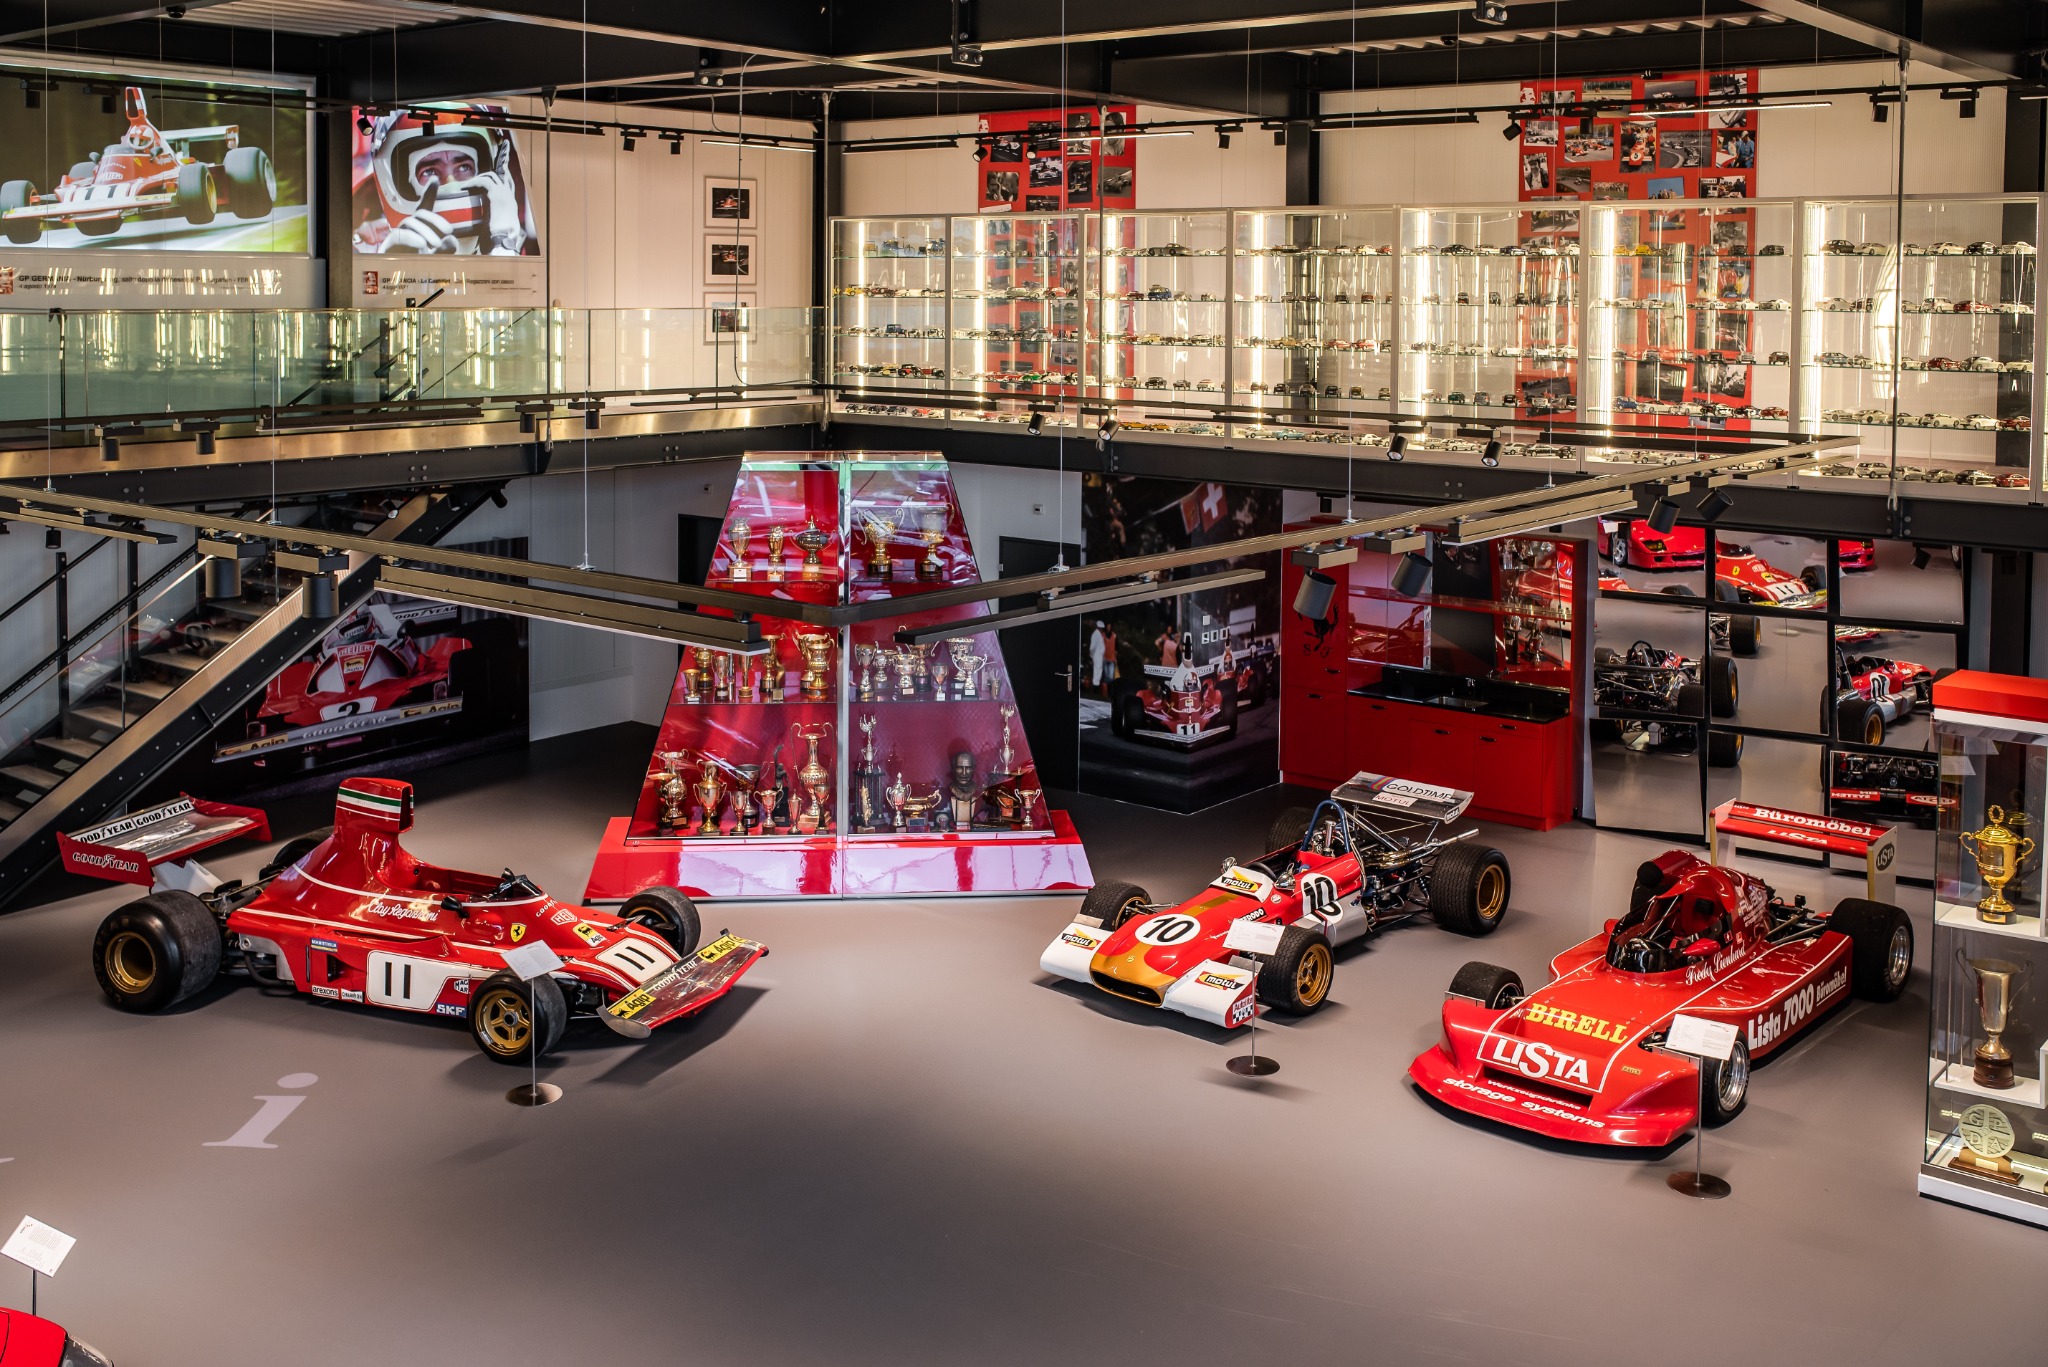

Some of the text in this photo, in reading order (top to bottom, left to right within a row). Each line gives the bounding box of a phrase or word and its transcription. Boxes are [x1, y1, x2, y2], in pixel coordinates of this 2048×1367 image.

[19, 275, 30, 283] GP
[394, 606, 459, 620] OODYEAR
[1753, 806, 1872, 837] Büromöbel
[1767, 829, 1828, 845] LISTA
[1876, 845, 1895, 867] LISTA
[1223, 877, 1253, 890] motul
[367, 899, 392, 918] Clay
[1303, 876, 1341, 922] 10
[1062, 934, 1092, 946] motul
[1143, 916, 1195, 942] 10
[614, 945, 656, 971] 11
[312, 986, 339, 996] arexons
[384, 961, 412, 999] 11
[1206, 975, 1238, 989] motul
[436, 1003, 466, 1016] SKF
[1748, 1012, 1781, 1051] Lista
[1783, 983, 1815, 1032] 7000
[1816, 965, 1848, 1003] Büromöbel
[1525, 1002, 1629, 1044] BIRELL
[1492, 1037, 1589, 1084] LISTA
[1442, 1077, 1606, 1129] storage systems
